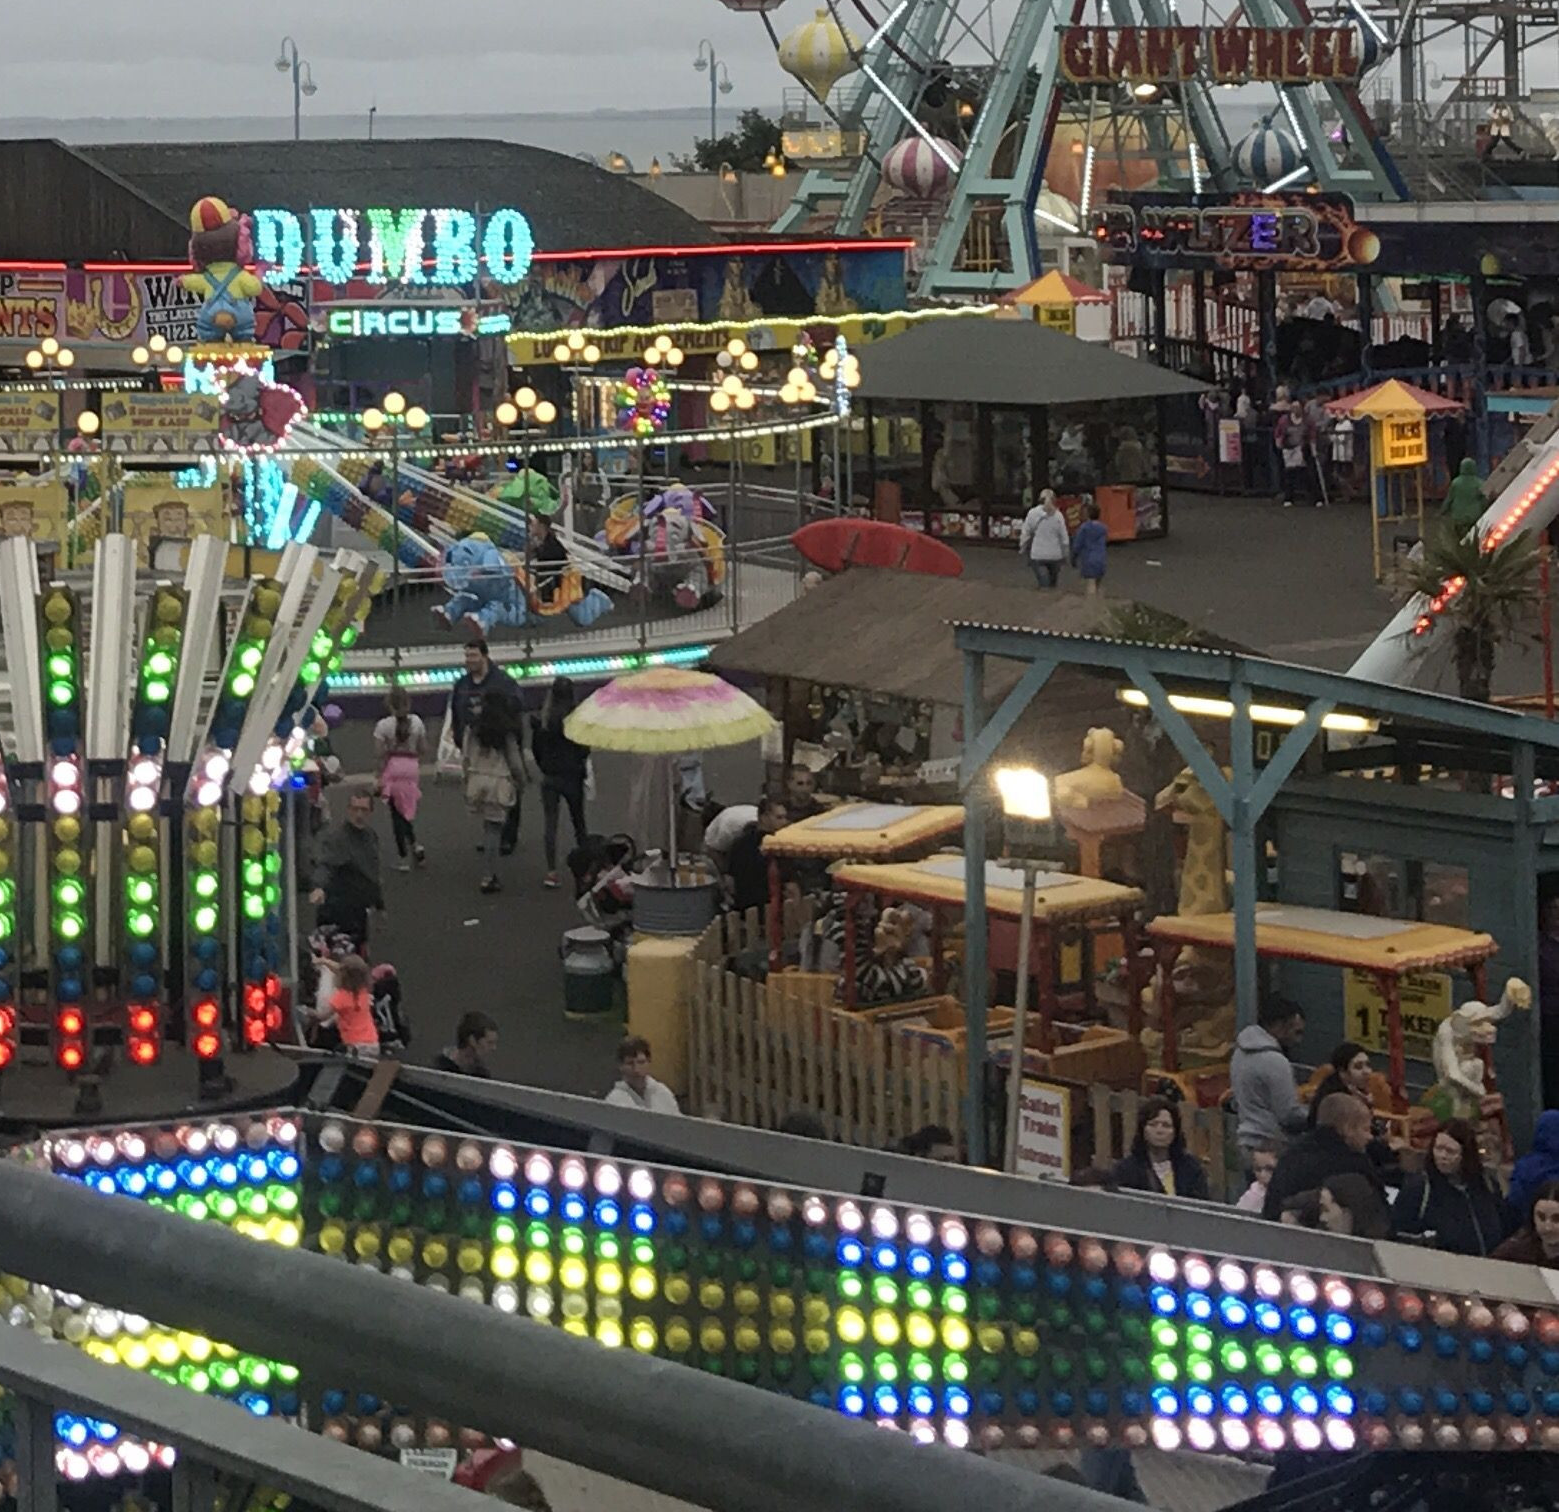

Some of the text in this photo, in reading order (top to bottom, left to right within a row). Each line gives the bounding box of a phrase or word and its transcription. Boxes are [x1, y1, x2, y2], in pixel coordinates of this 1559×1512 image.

[1060, 28, 1361, 84] GIANT WHEEL
[253, 207, 535, 286] DUMBO
[329, 309, 463, 336] CIRCUS
[1356, 1004, 1370, 1038] 1
